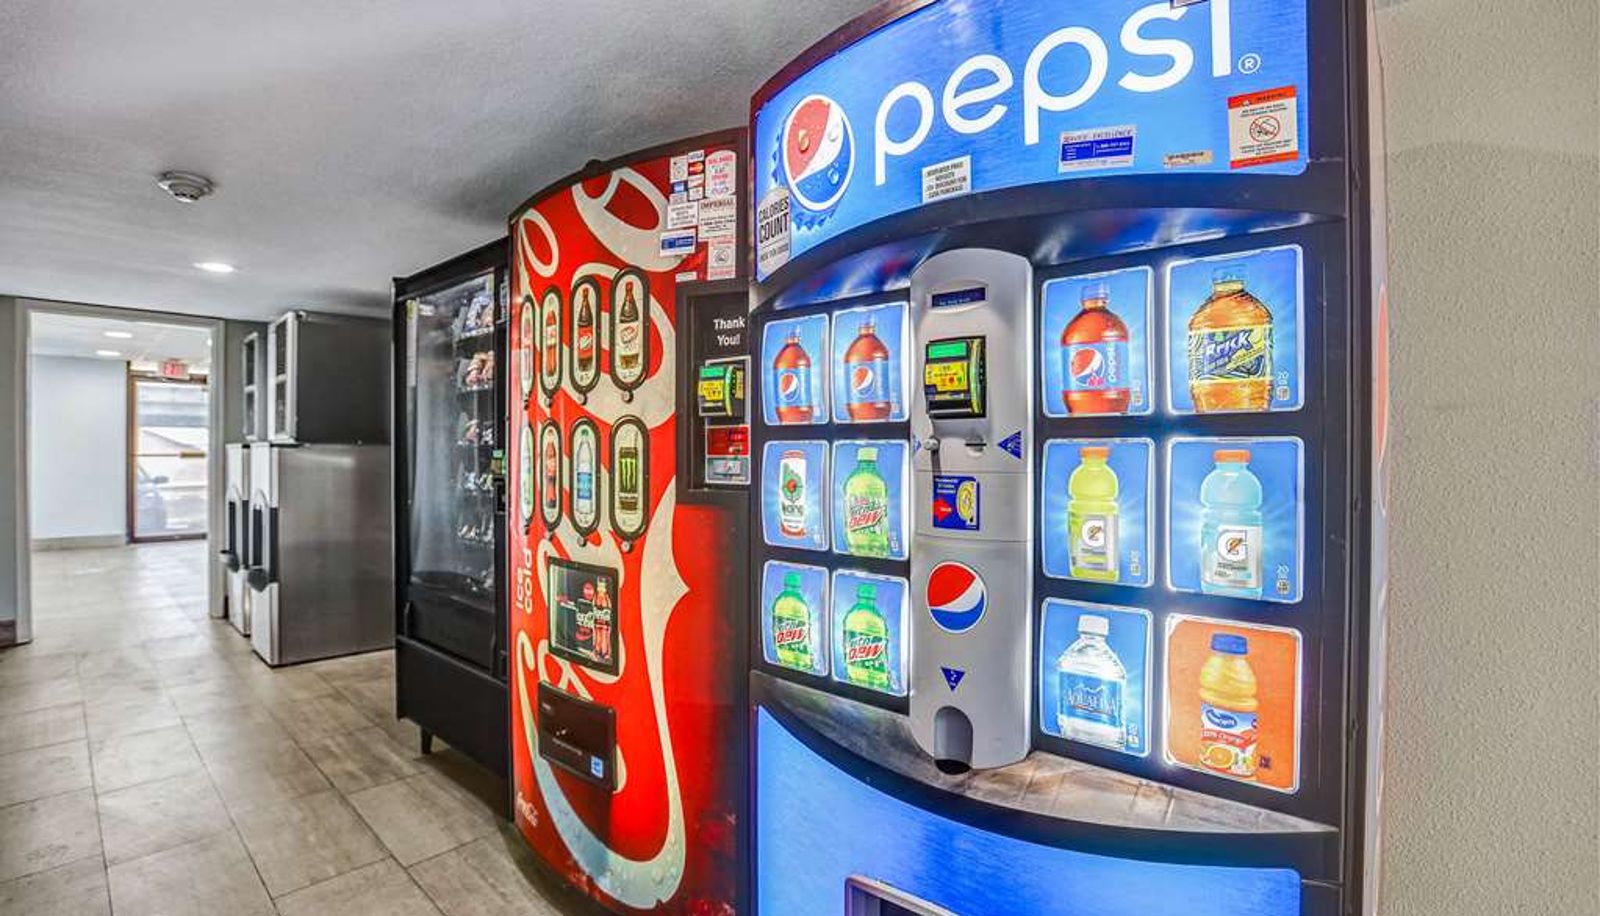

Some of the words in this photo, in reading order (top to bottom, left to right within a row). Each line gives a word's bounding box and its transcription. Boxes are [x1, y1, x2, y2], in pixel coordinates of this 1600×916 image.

[875, 0, 1231, 186] pepsi
[759, 195, 788, 223] CALORIES
[759, 212, 789, 243] COUNT
[713, 316, 745, 330] Thank
[717, 334, 740, 346] You!
[523, 548, 533, 614] cold
